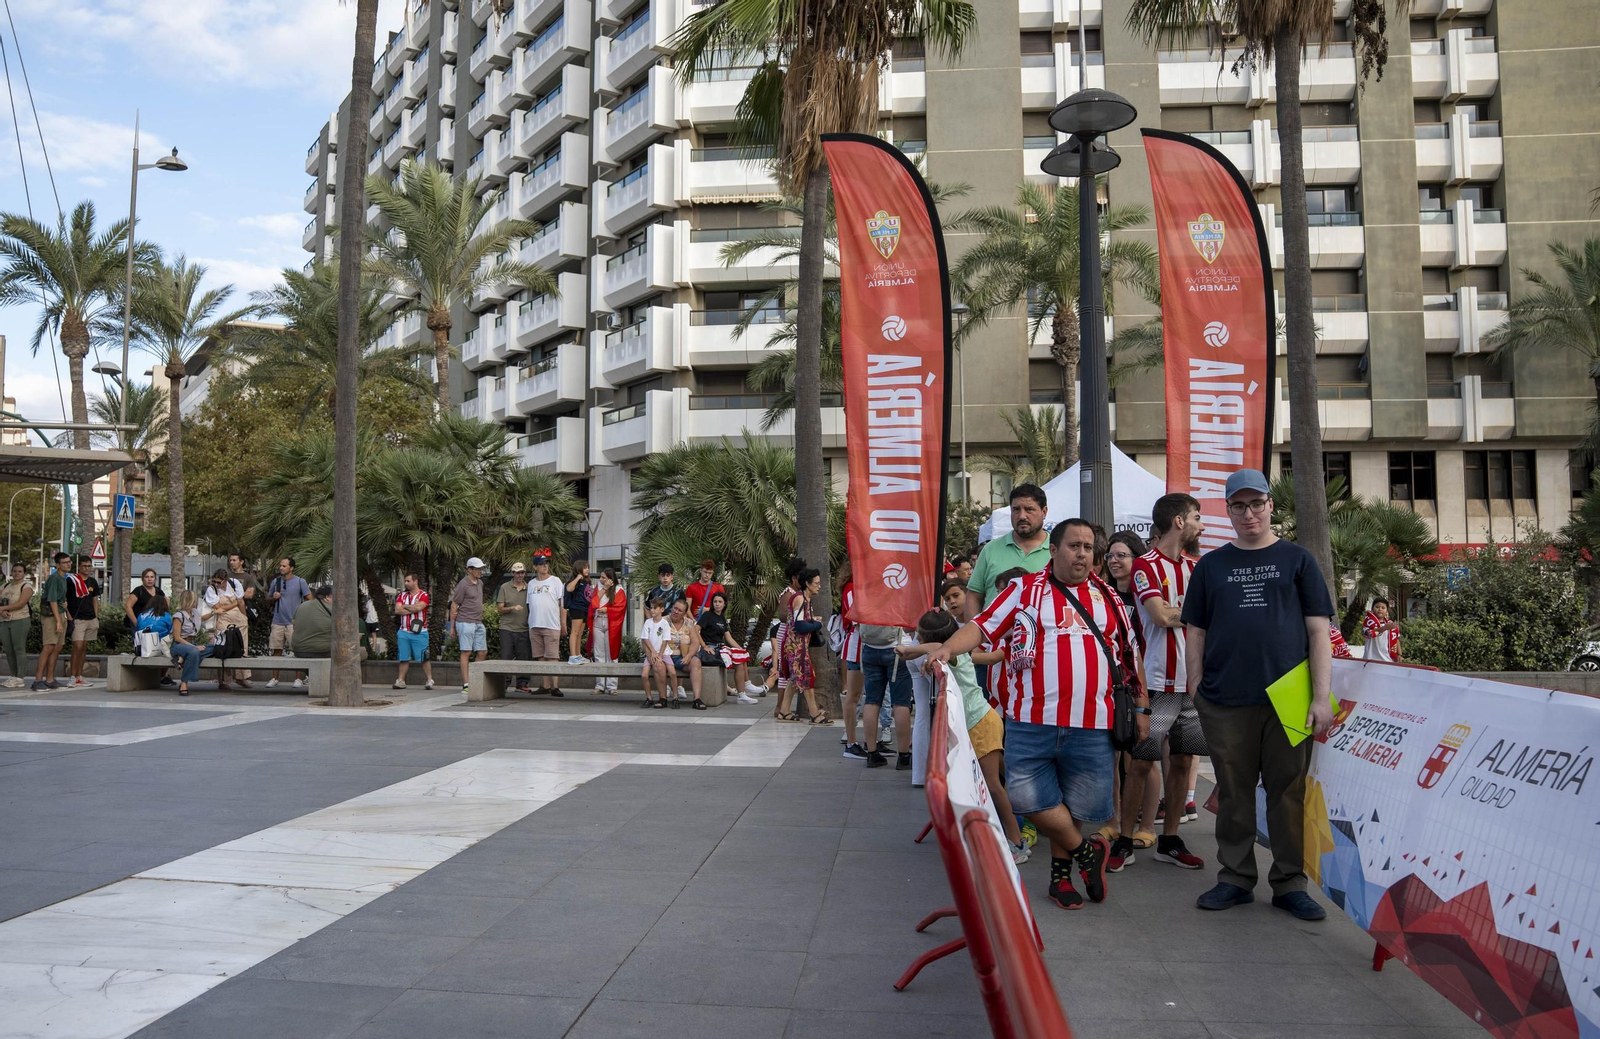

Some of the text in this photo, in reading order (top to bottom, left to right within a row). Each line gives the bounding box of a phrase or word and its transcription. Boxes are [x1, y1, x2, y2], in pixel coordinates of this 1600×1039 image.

[1113, 522, 1151, 532] TOMOT
[1227, 572, 1280, 582] BOROUGHS
[1255, 565, 1276, 573] FIVE
[1011, 649, 1035, 660] MERIA
[1361, 702, 1428, 724] PATRONATO MUNICIPAL DE
[1347, 715, 1409, 746] DEPORTES
[1333, 734, 1404, 771] DE ALMERIA
[1476, 738, 1594, 795] ALMERÍA
[1460, 776, 1516, 809] CIUDAD
